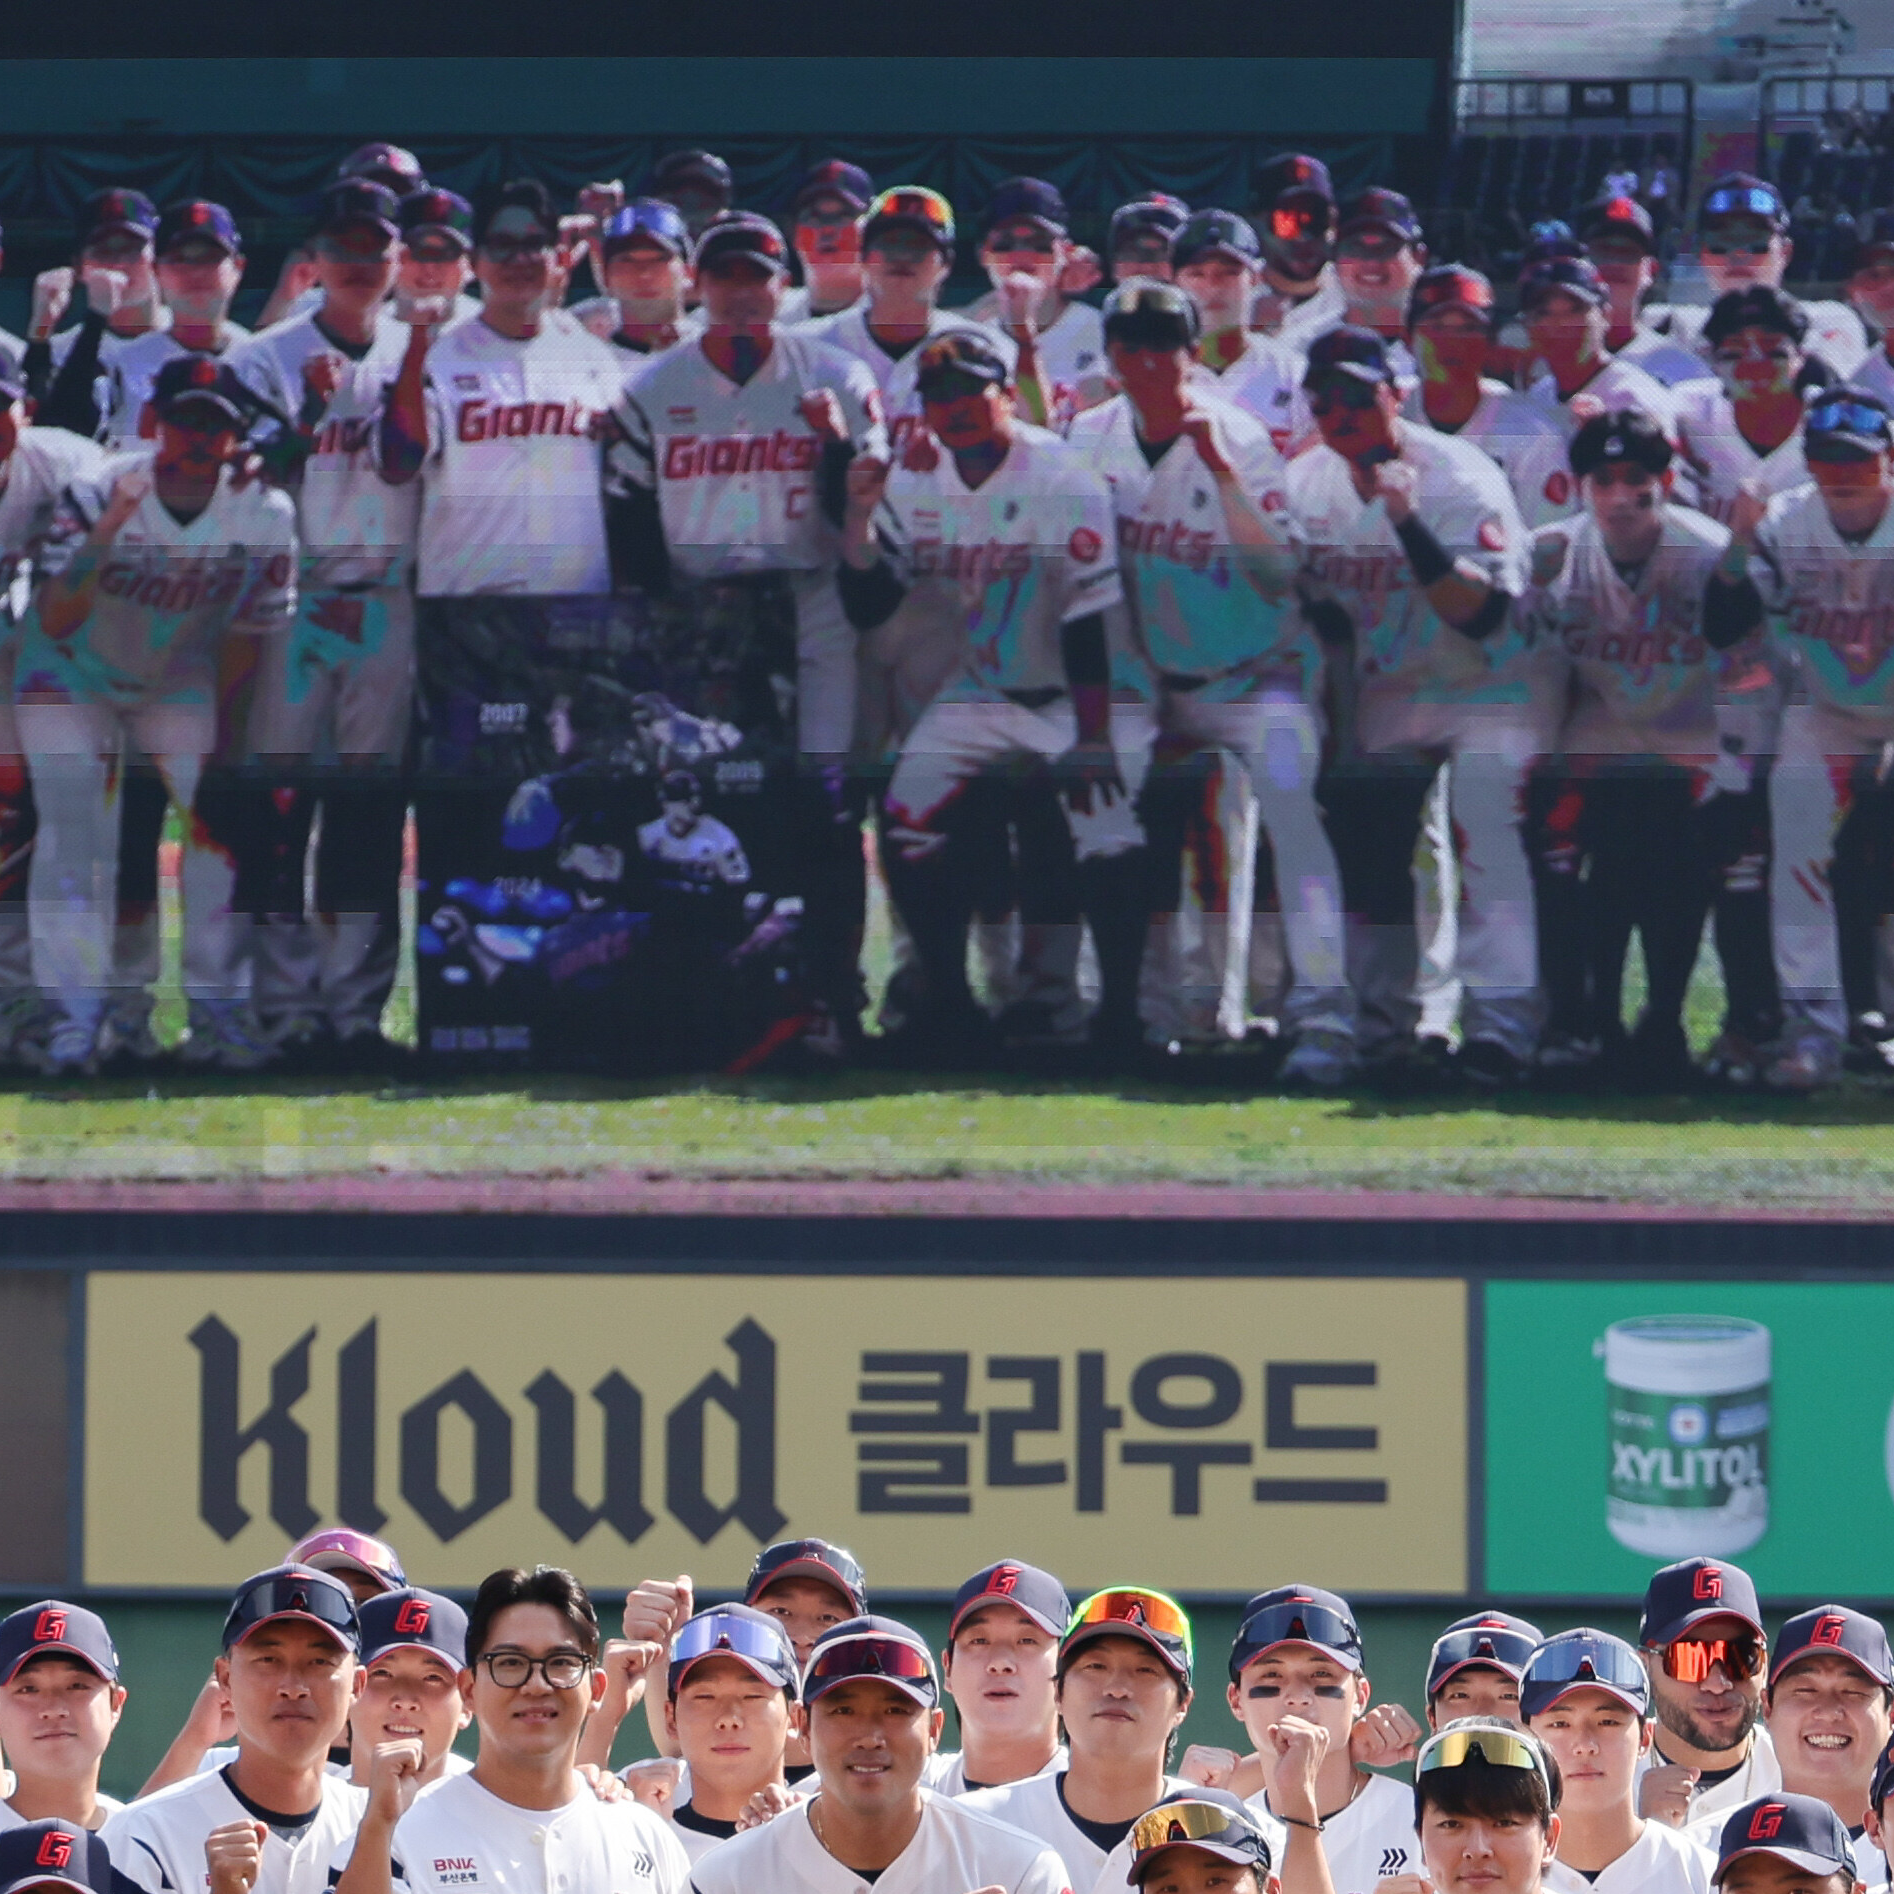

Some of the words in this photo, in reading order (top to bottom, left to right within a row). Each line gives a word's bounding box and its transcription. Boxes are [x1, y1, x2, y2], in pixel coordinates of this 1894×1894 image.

[187, 1311, 789, 1544] Kloud
[848, 1349, 1389, 1515] 클라우드
[434, 1858, 476, 1872] BNK
